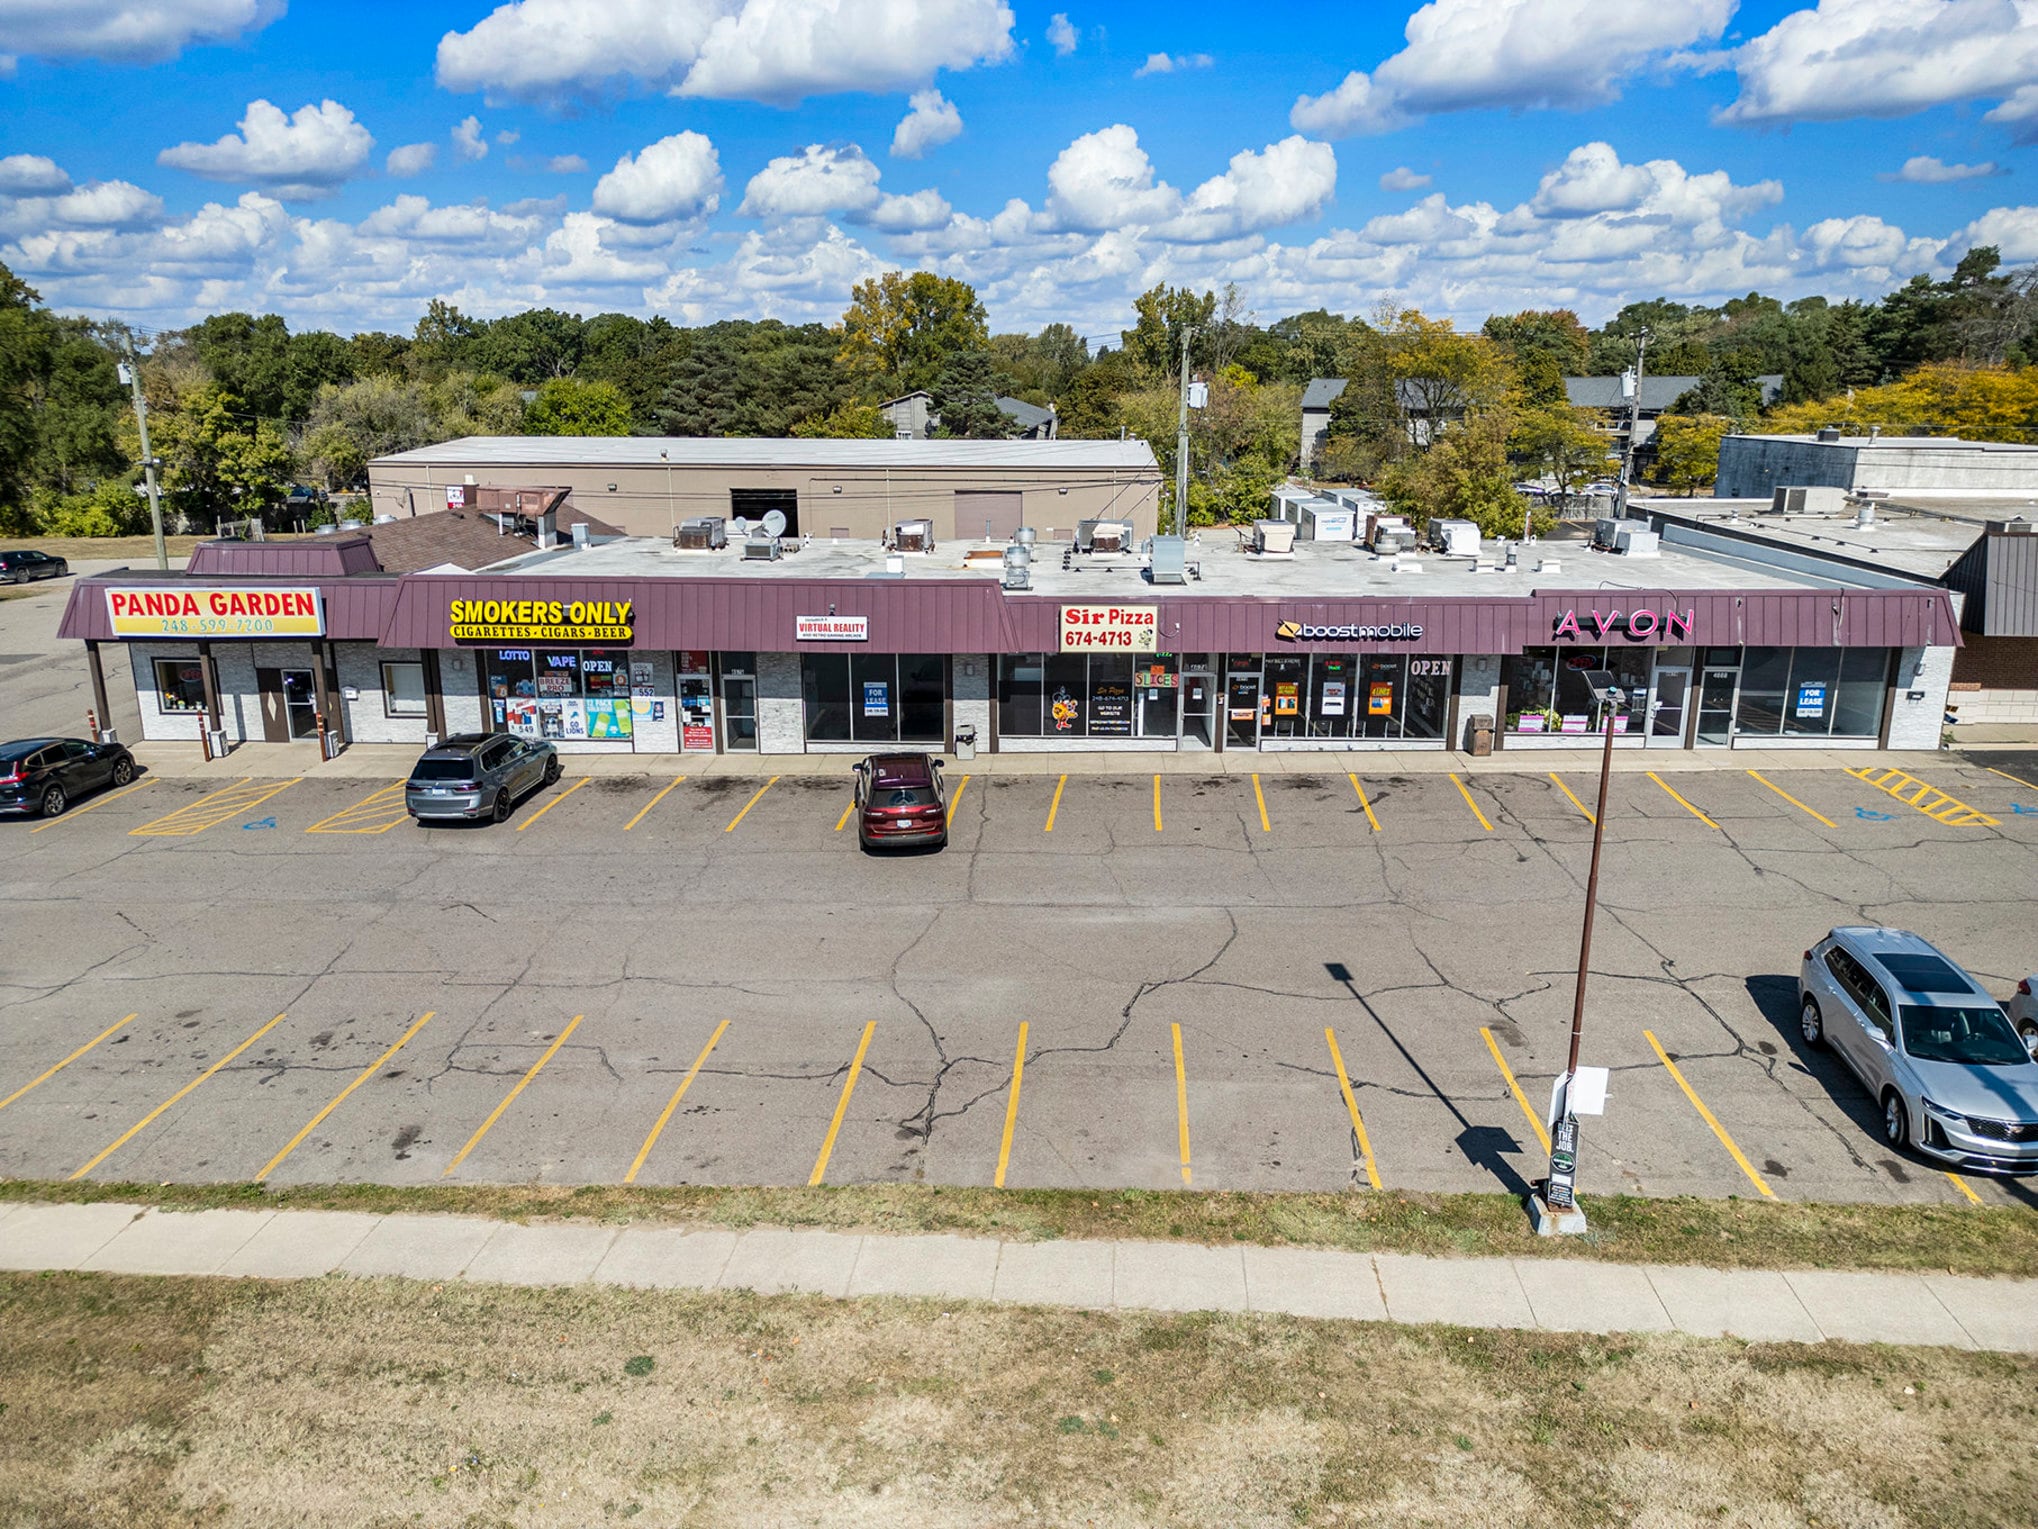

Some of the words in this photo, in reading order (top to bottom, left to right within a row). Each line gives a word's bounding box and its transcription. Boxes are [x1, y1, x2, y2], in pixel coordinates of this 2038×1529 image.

[111, 593, 200, 616] PANDA
[209, 592, 315, 616] GARDEN
[450, 600, 563, 624] SMOKERS
[569, 600, 632, 625] ONLY
[1065, 609, 1105, 625] Sir
[1109, 608, 1154, 625] Pizza
[162, 619, 273, 632] 248-599-7200
[799, 623, 832, 633] VIRTUAL
[833, 623, 865, 633] REALITY
[1556, 609, 1694, 636] AVON
[454, 625, 531, 638] CIGARETTES
[541, 625, 586, 638] CIGARS
[594, 625, 626, 638] BEER
[1303, 622, 1424, 638] boostmobile
[1065, 631, 1132, 647] 674-4713
[499, 650, 530, 661] LOTTO
[547, 655, 577, 668] VAPE
[583, 660, 612, 672] OPEN
[1411, 660, 1452, 676] OPEN
[539, 678, 570, 686] BREEZE
[1135, 672, 1179, 687] SLICES
[868, 689, 883, 697] FOR
[1804, 689, 1820, 697] FOR
[1799, 697, 1823, 705] LEASE
[566, 727, 584, 735] LIONS
[1558, 1130, 1573, 1142] THE
